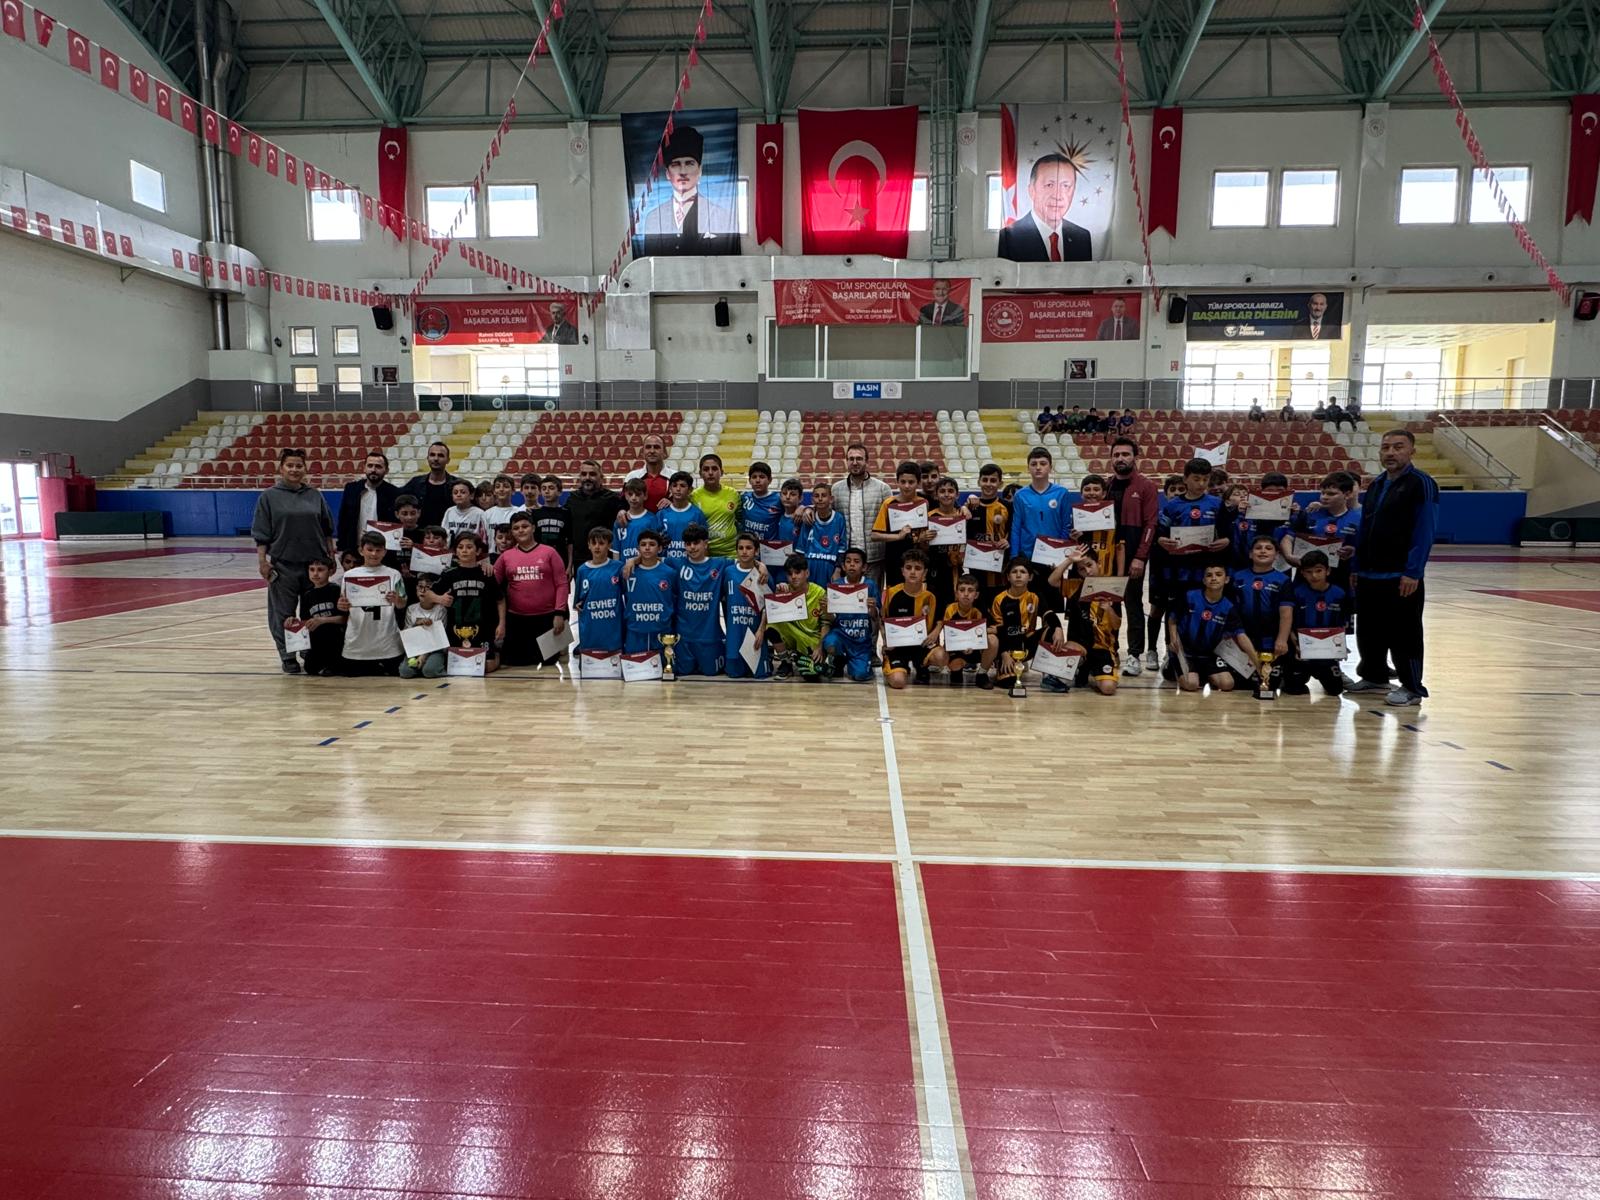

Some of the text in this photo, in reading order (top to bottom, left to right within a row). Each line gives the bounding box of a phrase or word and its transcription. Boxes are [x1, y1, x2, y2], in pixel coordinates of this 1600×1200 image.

[836, 281, 908, 290] TÜM SPORCULARA
[832, 290, 910, 301] BAŞARILAR DİLERİM
[1032, 300, 1046, 308] TÜM
[1208, 302, 1284, 310] TÜM SPORCULARIMIZA
[466, 308, 480, 316] TÜM
[1029, 308, 1094, 320] BAŞARILAR DİLERİM
[1192, 308, 1299, 322] BAŞARILAR DİLERİM
[463, 316, 528, 326] BAŞARILAR DİLERİM
[743, 496, 754, 510] 20
[808, 529, 814, 543] 4
[517, 566, 540, 574] BELDE
[680, 565, 694, 580] 10
[513, 573, 544, 581] MARKET
[582, 579, 589, 594] 9
[626, 577, 636, 592] 17
[728, 580, 734, 595] 11
[683, 591, 713, 601] CEVHER
[632, 603, 664, 612] CEVHER
[685, 602, 710, 611] MODA
[591, 610, 616, 620] MODA
[636, 613, 660, 622] MODA
[732, 616, 754, 625] MODA
[840, 619, 869, 628] CEVHER
